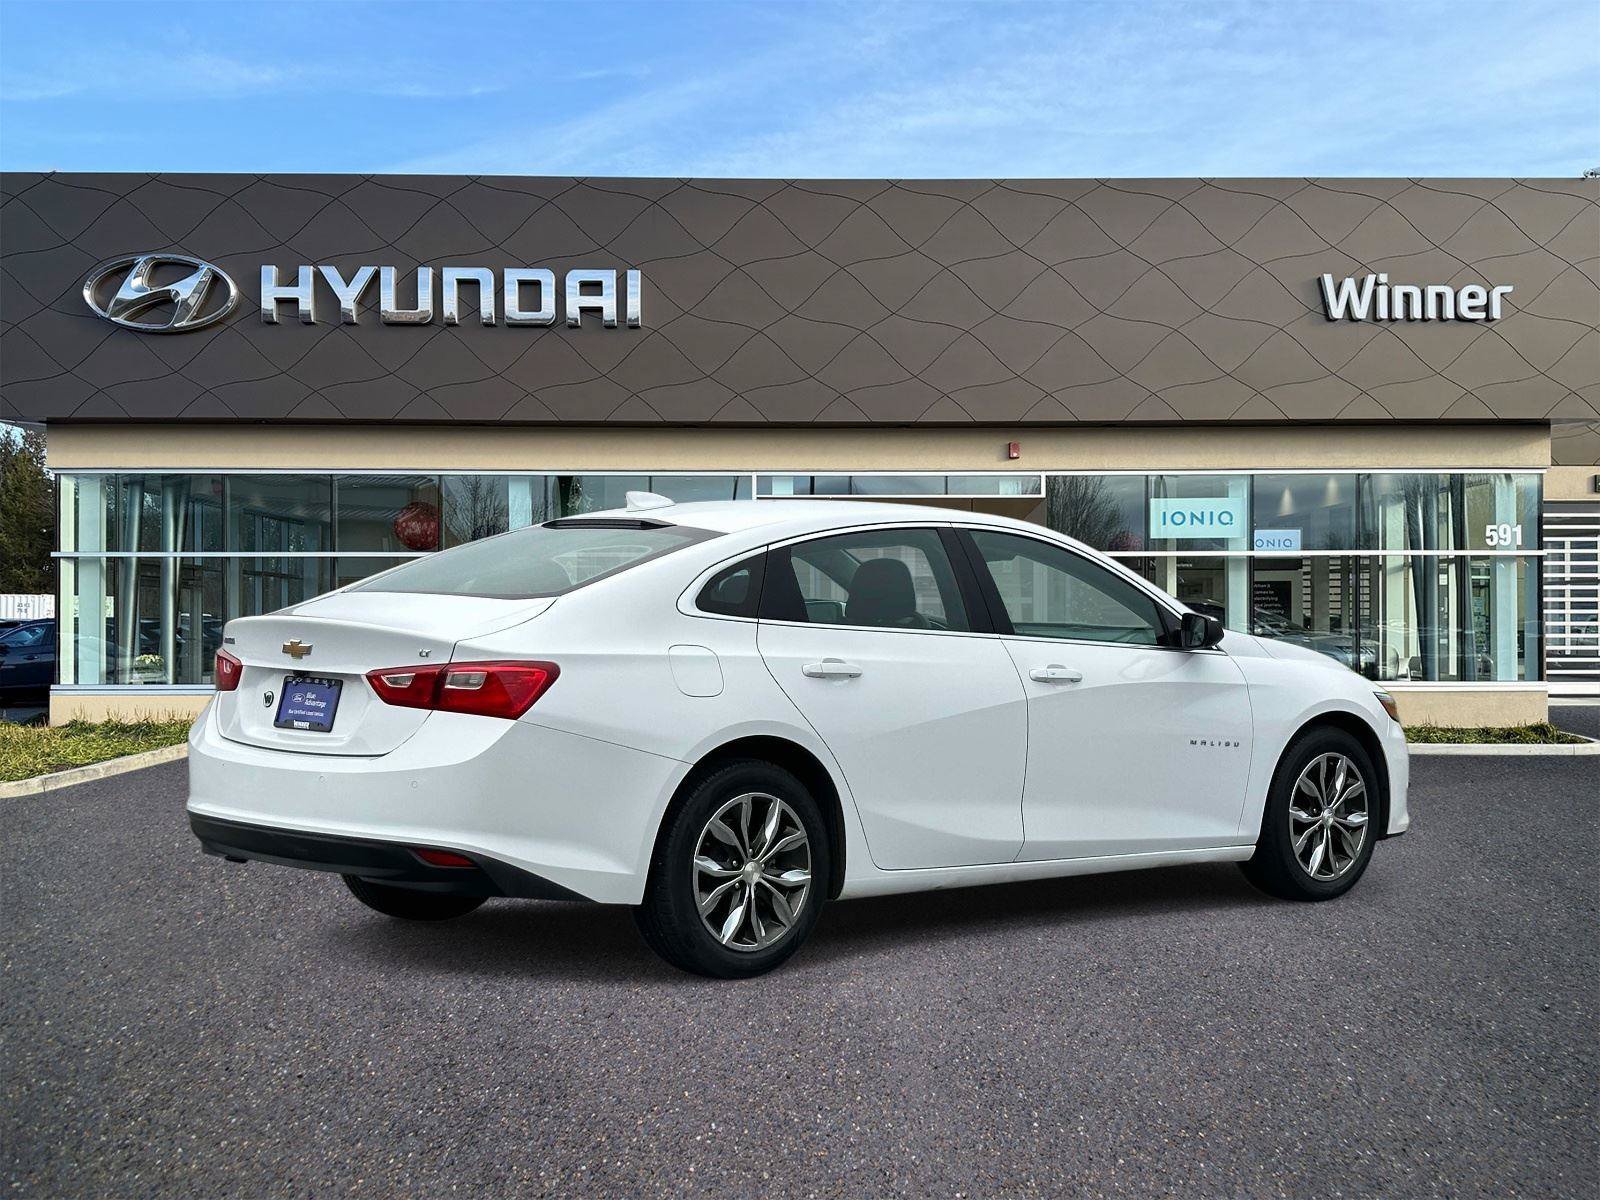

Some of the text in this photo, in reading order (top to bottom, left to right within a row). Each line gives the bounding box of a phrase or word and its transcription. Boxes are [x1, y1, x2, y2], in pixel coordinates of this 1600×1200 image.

[260, 265, 642, 328] HYUNDAI
[1320, 273, 1513, 321] Winner
[1161, 510, 1234, 526] IONIQ
[1255, 538, 1293, 548] ONIQ
[1485, 523, 1522, 546] 591
[1190, 739, 1240, 748] MALIBU
